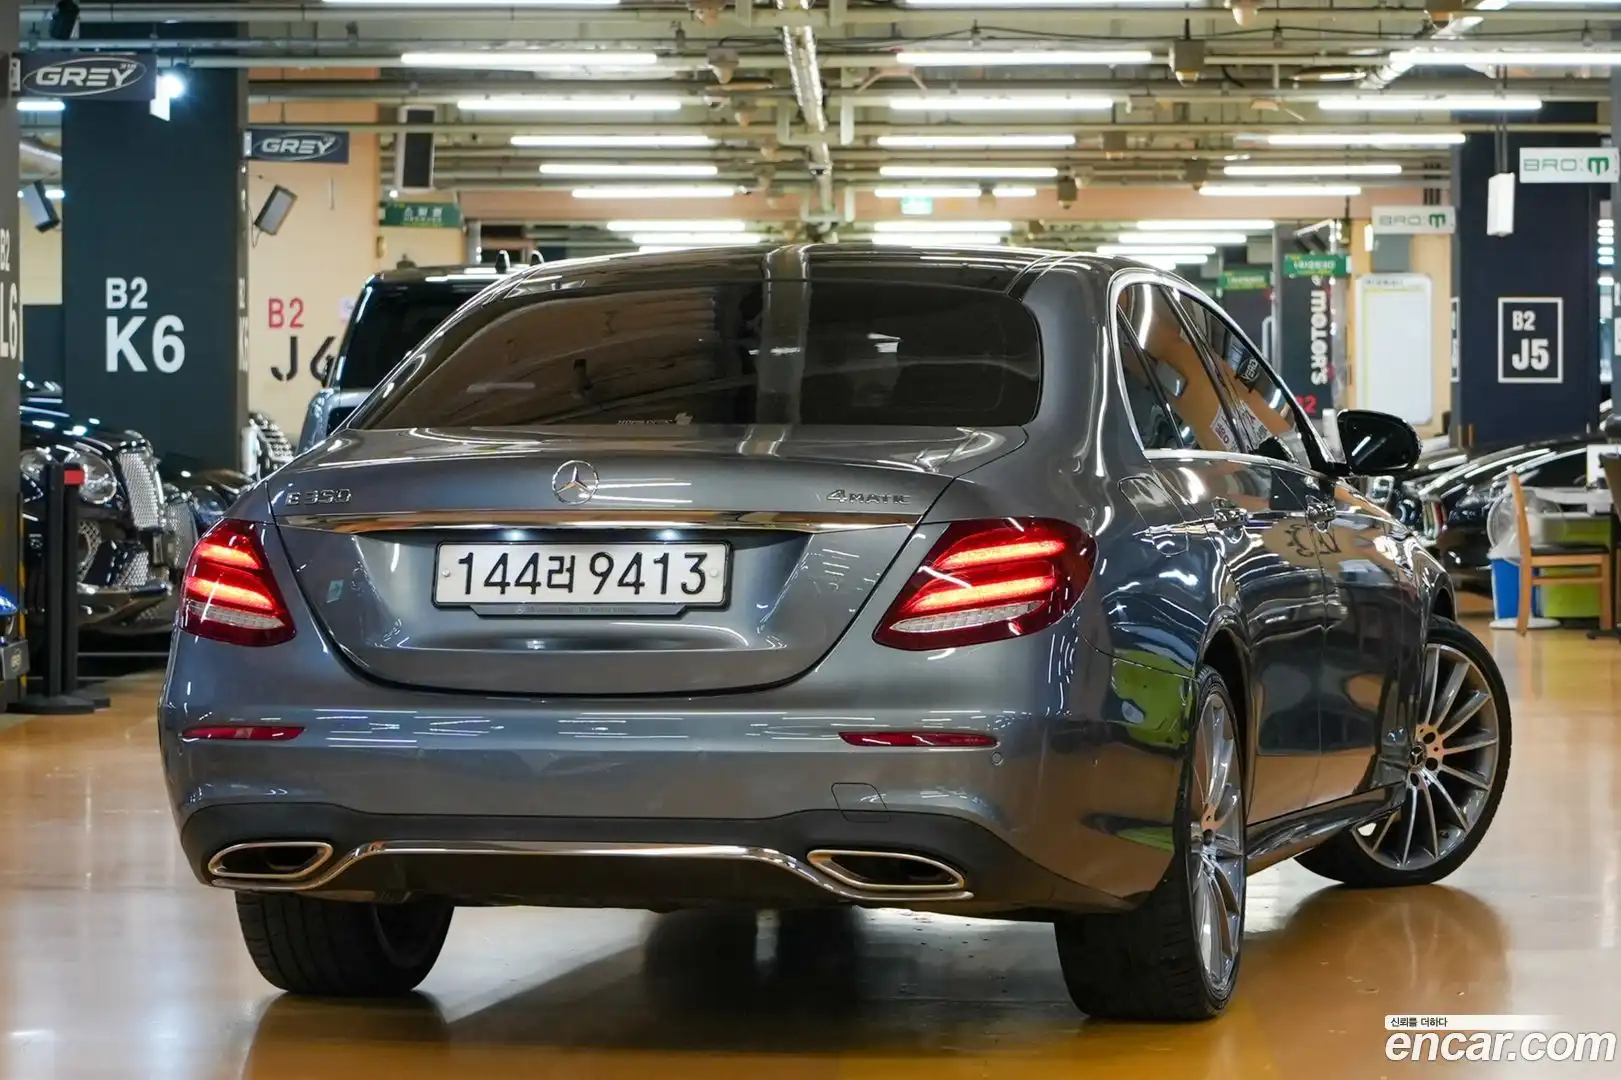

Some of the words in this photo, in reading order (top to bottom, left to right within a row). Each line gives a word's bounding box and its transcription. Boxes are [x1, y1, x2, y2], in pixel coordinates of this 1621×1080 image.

[35, 66, 137, 88] GREY
[262, 136, 335, 155] GREY
[105, 276, 149, 310] B2
[267, 297, 305, 329] B2
[1512, 310, 1536, 331] B2
[105, 314, 186, 374] K6
[1511, 338, 1550, 371] J5
[285, 491, 301, 505] E
[304, 488, 352, 504] 350
[826, 488, 912, 506] 4MATIC
